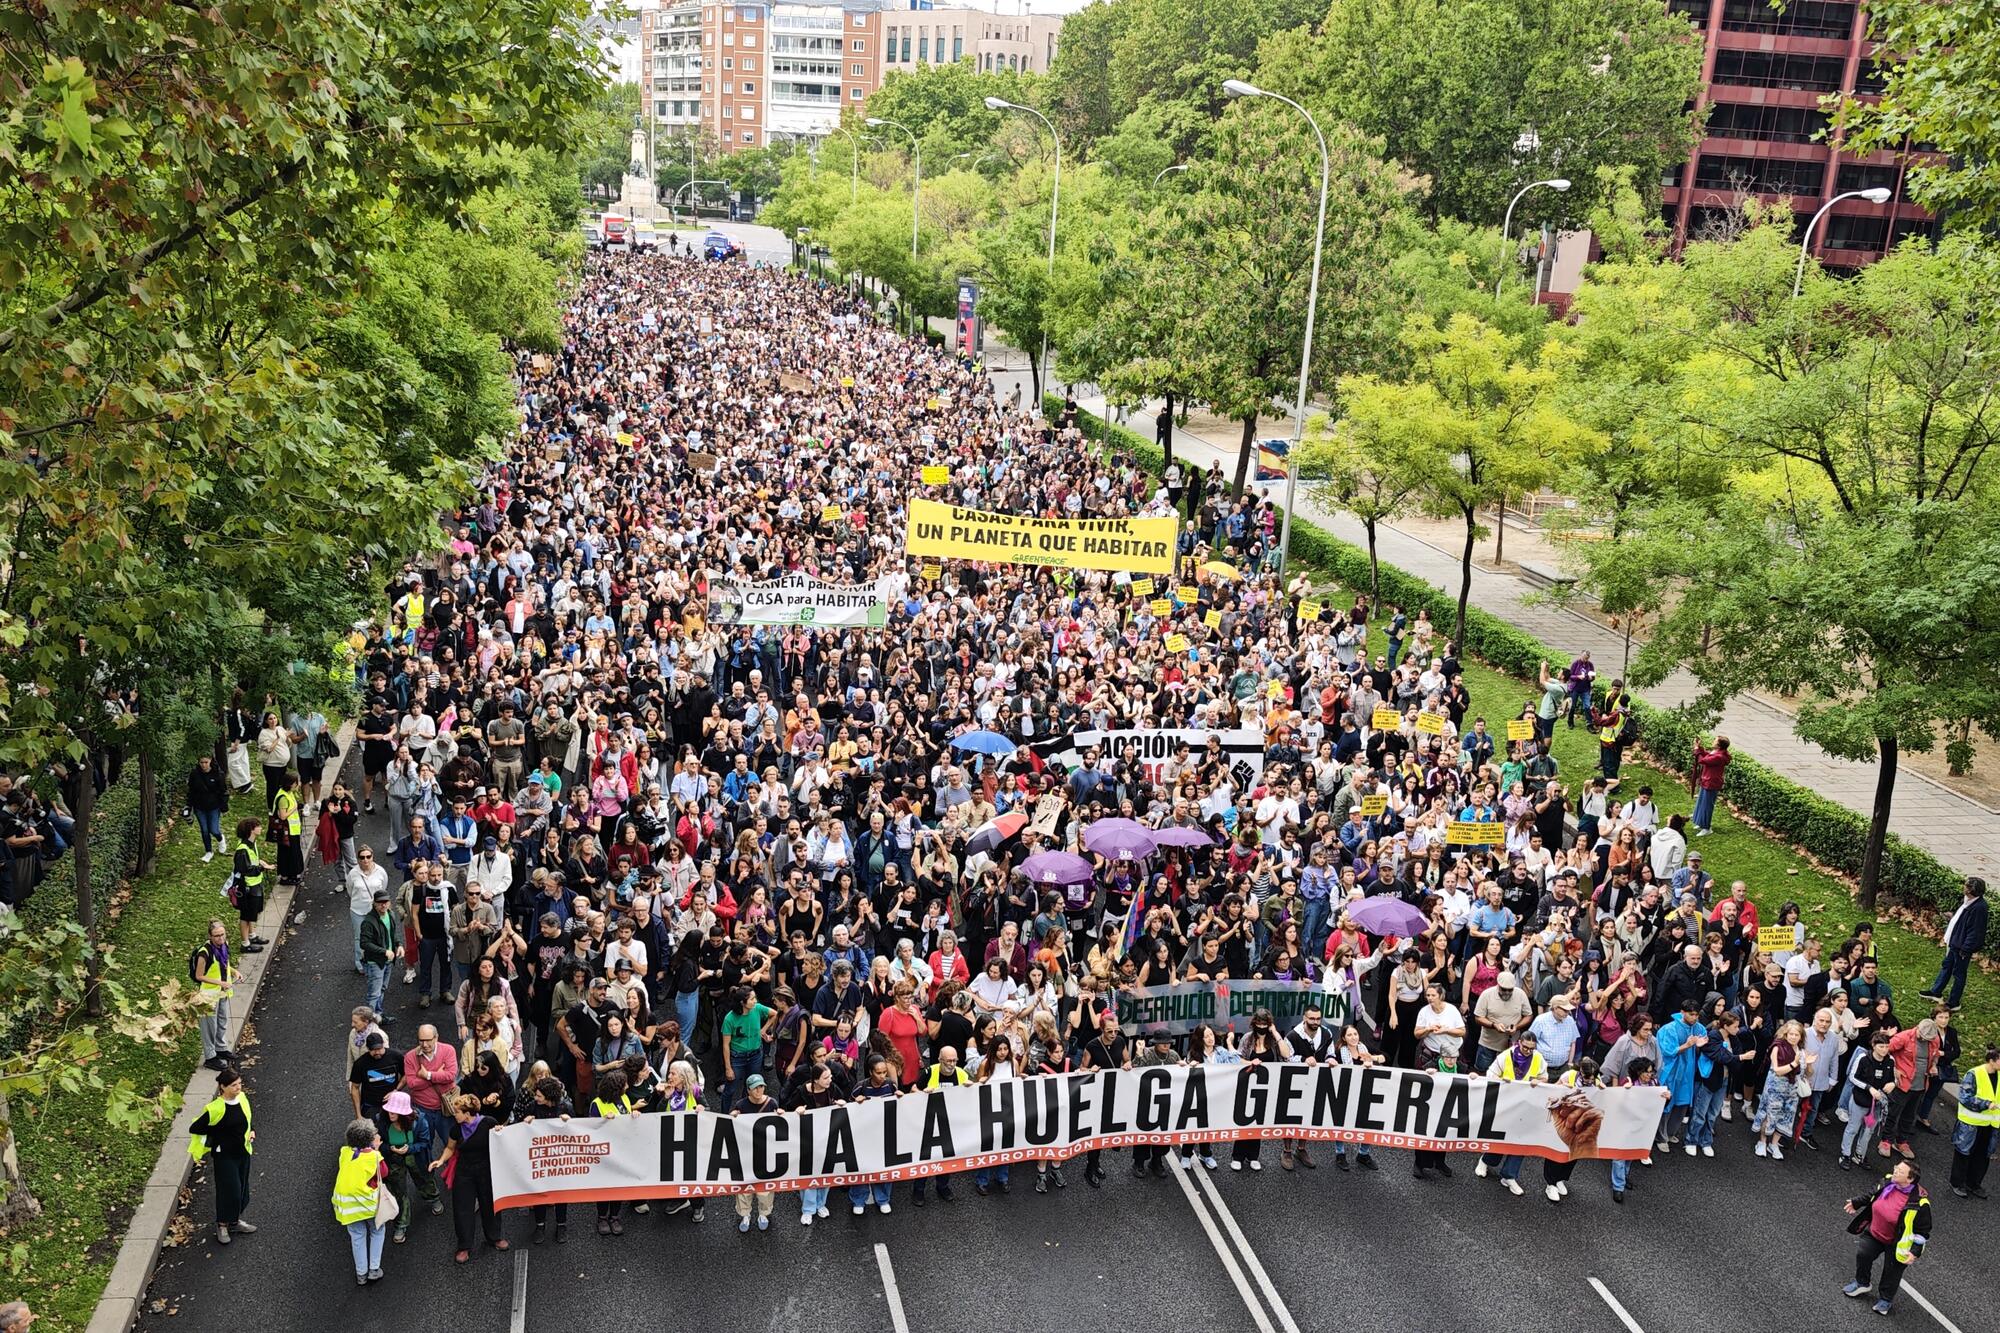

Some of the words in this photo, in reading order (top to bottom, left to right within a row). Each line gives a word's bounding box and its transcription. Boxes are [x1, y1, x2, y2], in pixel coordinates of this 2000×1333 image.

[917, 523, 944, 540] UN
[950, 526, 1032, 548] PLANETA
[1039, 534, 1077, 552] QUE
[1084, 537, 1168, 558] HABITAR
[1012, 553, 1068, 565] GREENPEACE
[746, 592, 783, 605] CASA
[787, 596, 812, 607] para
[816, 593, 877, 607] HABITAR
[1101, 731, 1181, 759] ACCIÓN
[660, 1107, 859, 1182] HACIA
[884, 1091, 956, 1168] LA
[978, 1067, 1209, 1152] HUELGA
[1233, 1064, 1506, 1140] GENERAL
[531, 1134, 591, 1146] SINDICATO
[531, 1147, 546, 1158] DE
[547, 1144, 609, 1156] INQUILINAS
[532, 1160, 538, 1169] E
[540, 1156, 601, 1168] INQUILINOS
[678, 1184, 756, 1196] BAJADA
[764, 1180, 800, 1191] DEL
[808, 1170, 901, 1187] ALQUILER
[909, 1163, 944, 1177] 50%
[965, 1140, 1094, 1169] EXPROPIACIÓN
[1101, 1134, 1172, 1147] FONDOS
[1179, 1130, 1240, 1143] BUITRE
[1261, 1128, 1365, 1141] CONTRATOS
[1373, 1134, 1491, 1151] INDEFINIDOS
[532, 1170, 546, 1180] DE
[547, 1166, 590, 1177] MADRID
